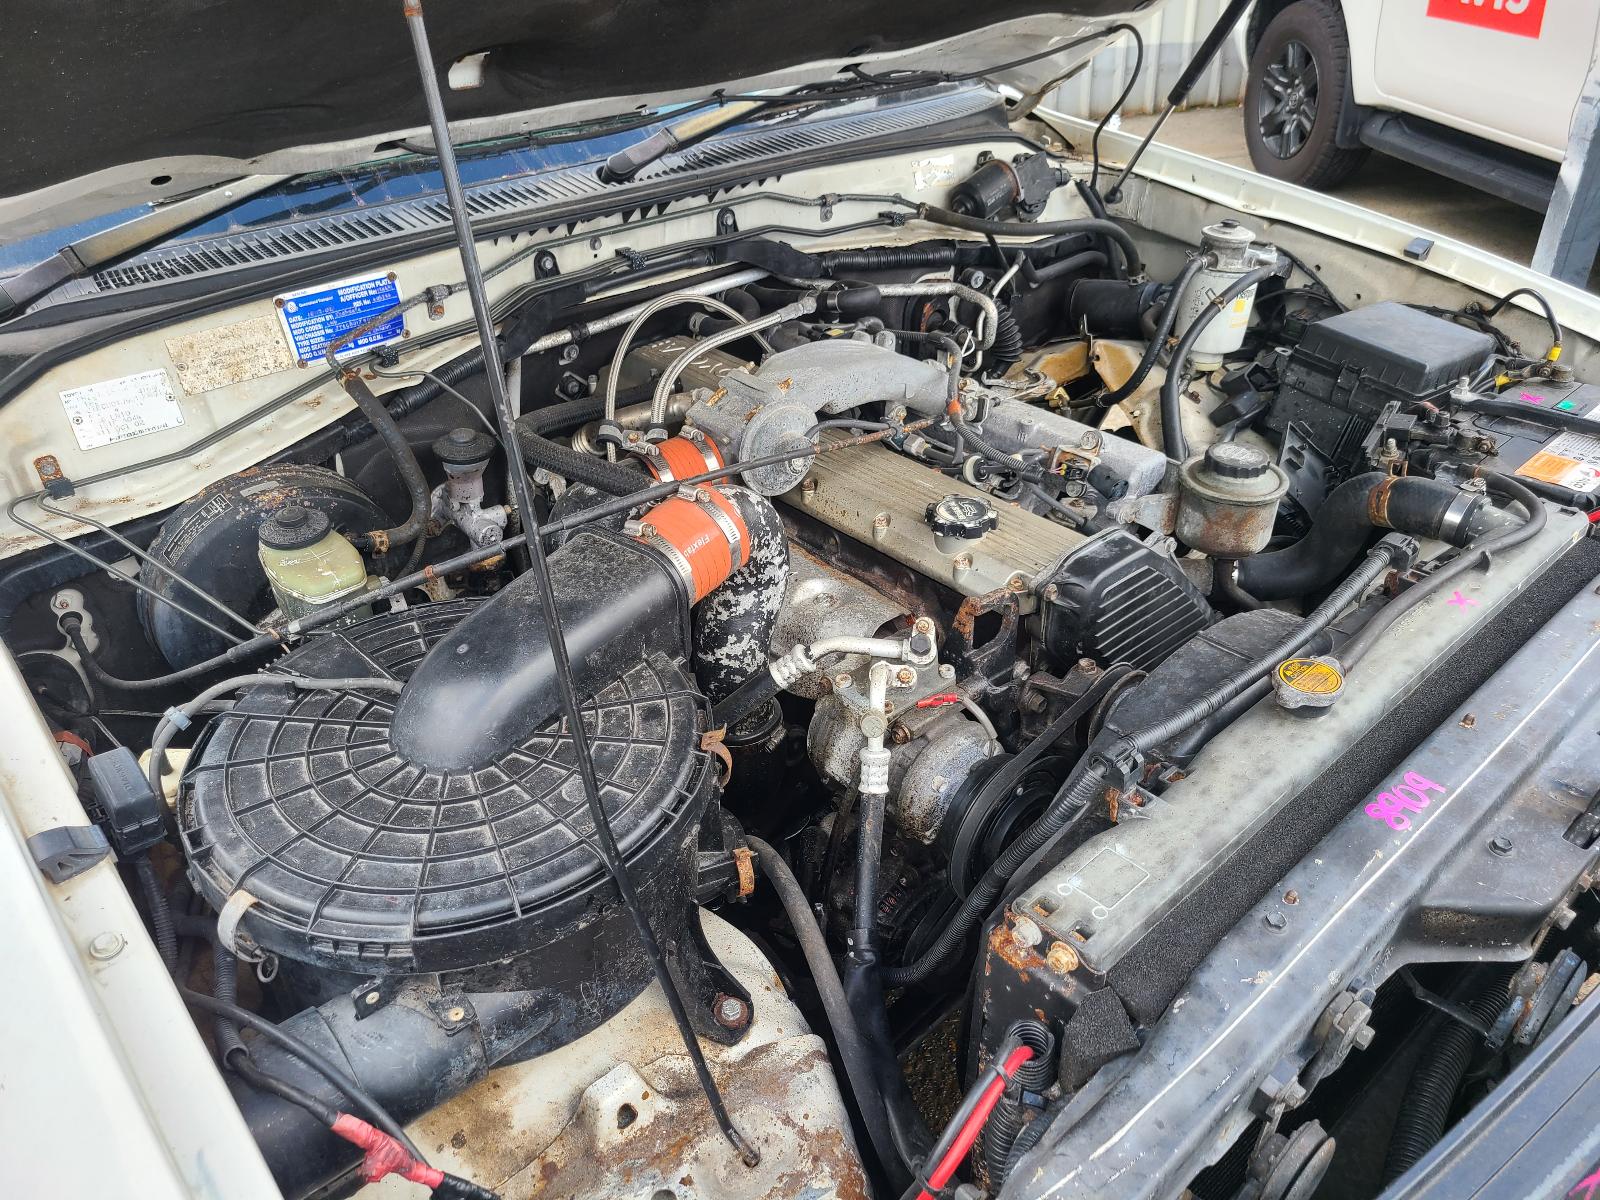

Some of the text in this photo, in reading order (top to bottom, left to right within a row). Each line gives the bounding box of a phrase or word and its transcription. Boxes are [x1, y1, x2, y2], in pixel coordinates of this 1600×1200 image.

[338, 282, 375, 296] MODIFICATION
[289, 315, 302, 323] DATE:
[291, 316, 325, 330] MODIFICATION
